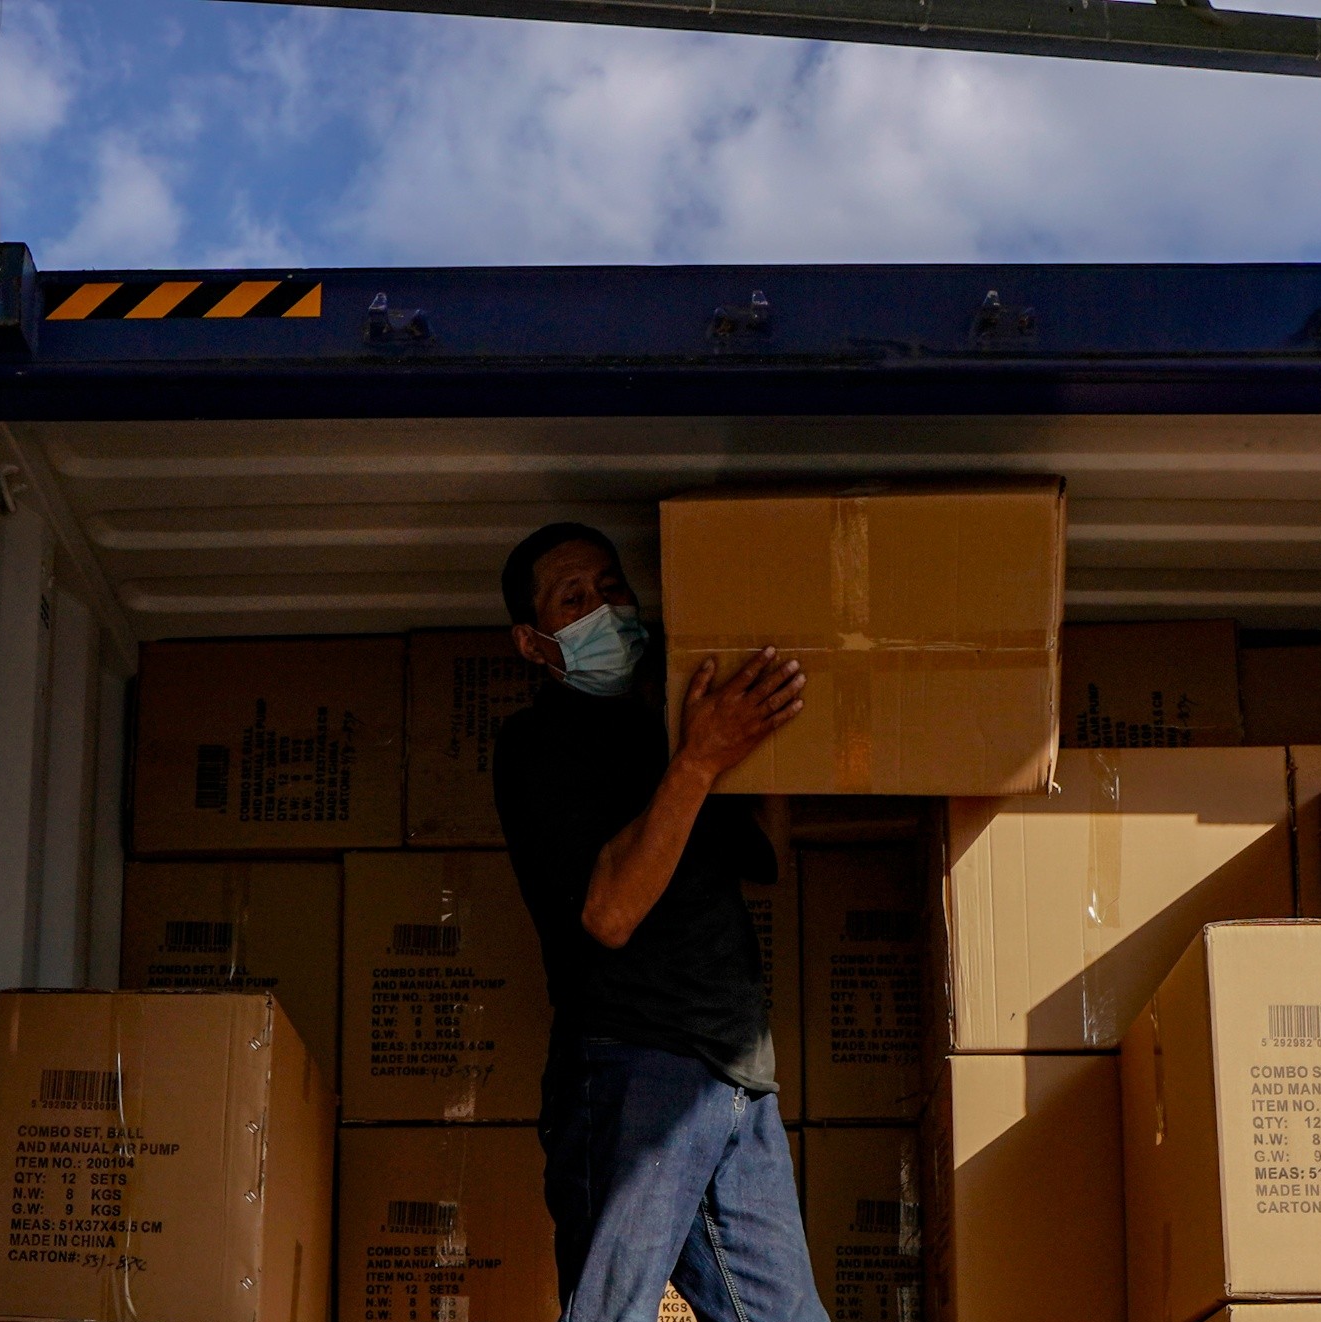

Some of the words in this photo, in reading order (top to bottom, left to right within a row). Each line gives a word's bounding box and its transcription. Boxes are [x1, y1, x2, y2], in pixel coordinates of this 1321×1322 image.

[17, 1125, 71, 1137] COMBO
[107, 1127, 144, 1139] BALL
[1254, 1167, 1304, 1180] MEAS:
[1255, 1184, 1301, 1197] MADE
[1305, 1184, 1320, 1196] IN
[9, 1234, 50, 1246] MADE
[53, 1235, 67, 1246] IN
[70, 1235, 116, 1248] CHINA
[662, 1302, 688, 1313] KGS
